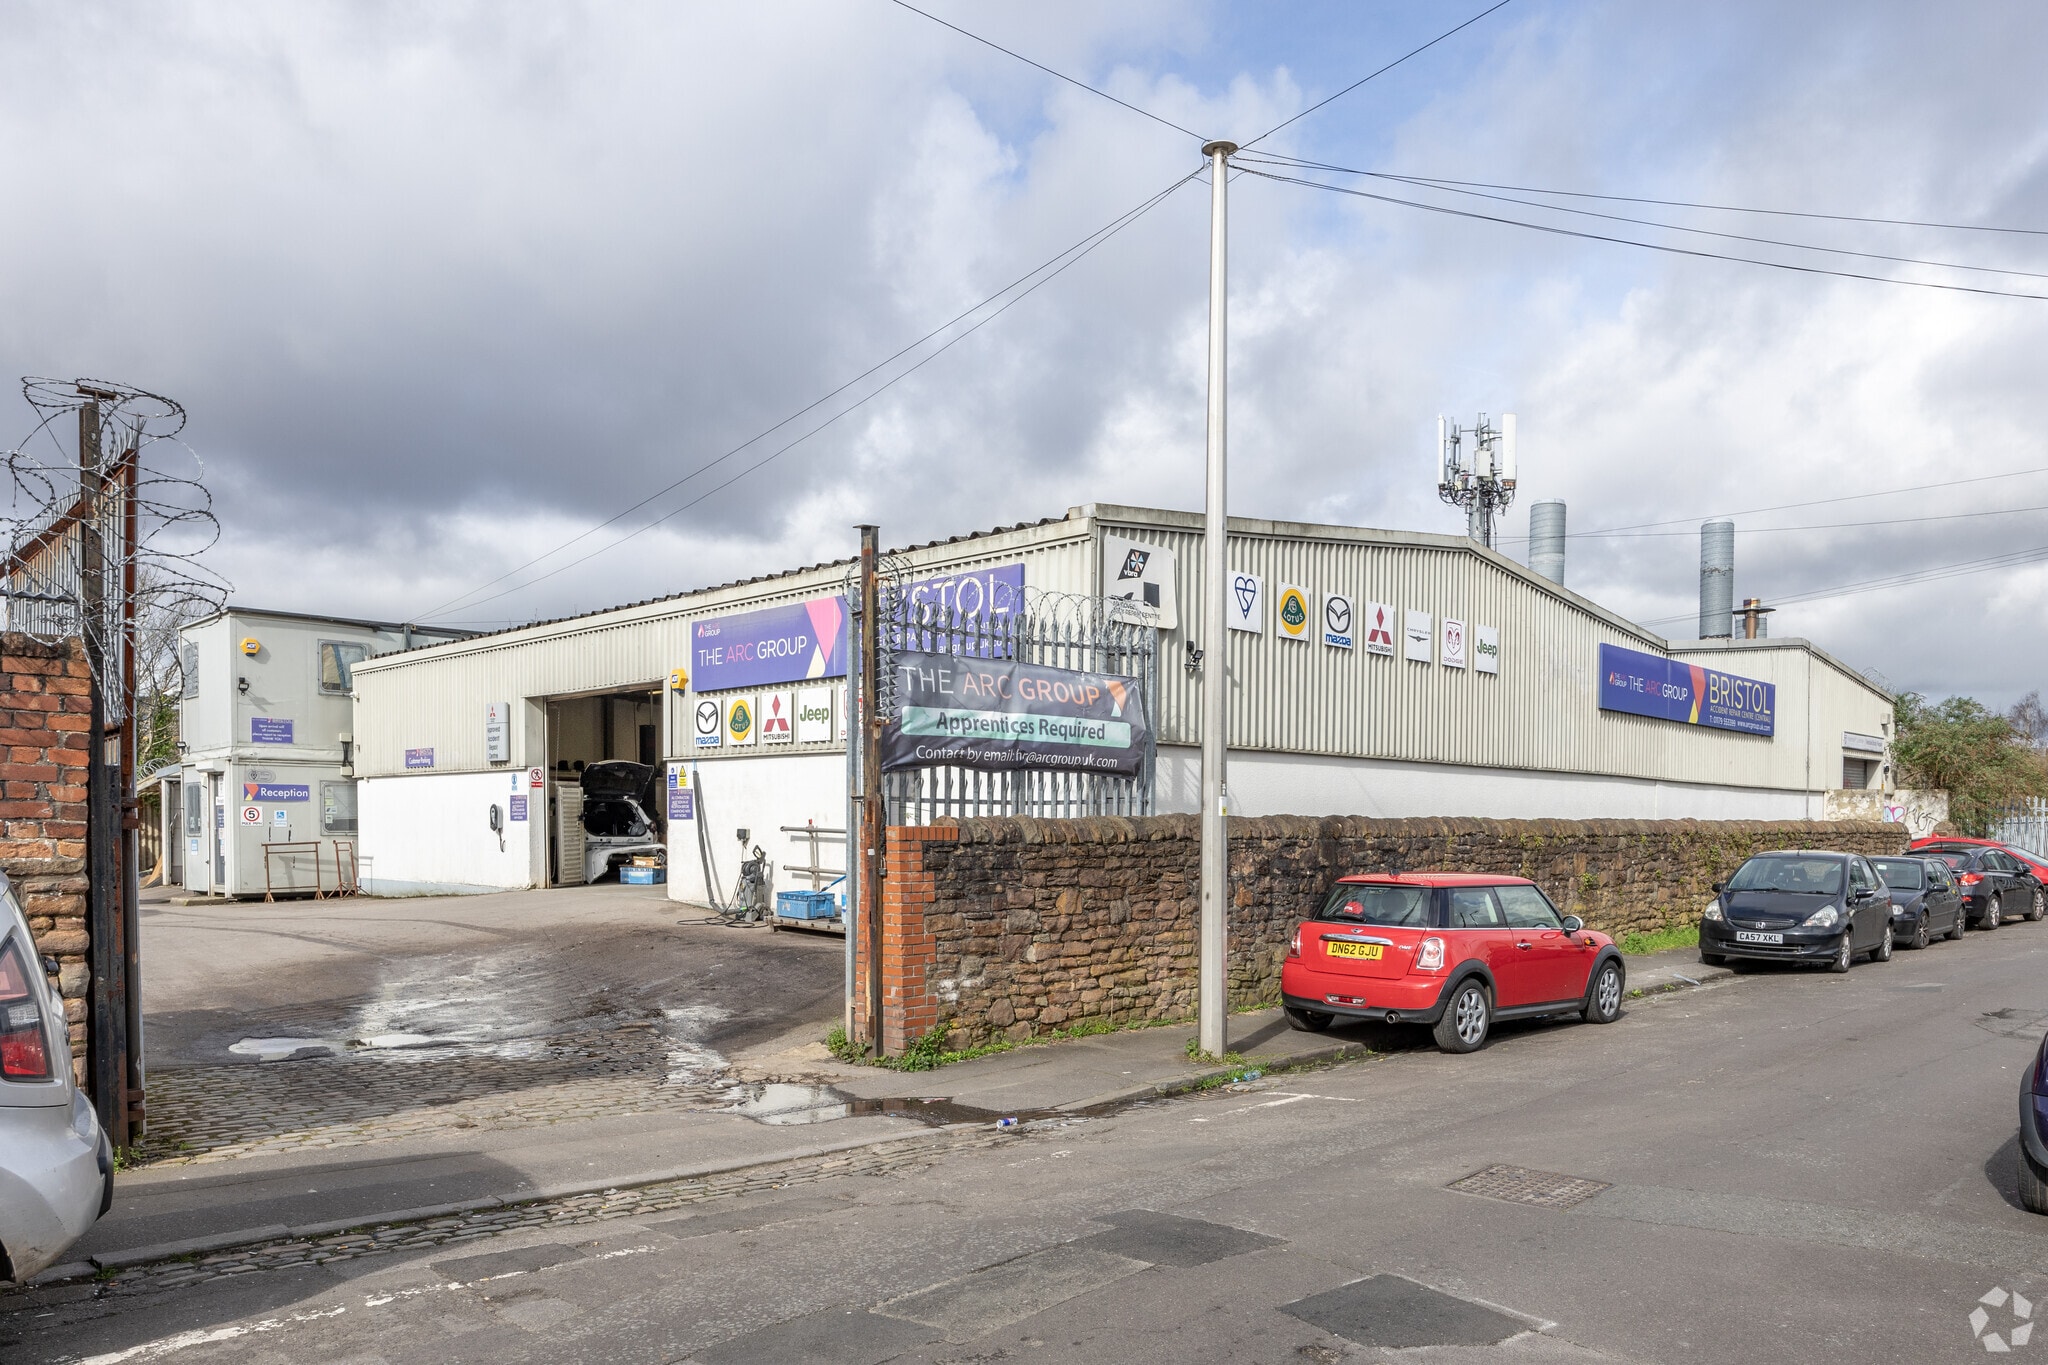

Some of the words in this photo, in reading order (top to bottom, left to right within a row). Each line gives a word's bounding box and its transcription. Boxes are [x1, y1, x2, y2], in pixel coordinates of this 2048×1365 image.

[1283, 611, 1304, 623] LOTUS
[704, 628, 721, 637] GROUP
[1407, 627, 1431, 635] CHRYSLER
[1325, 633, 1351, 646] mazda
[698, 647, 723, 667] THE
[726, 642, 754, 664] ARC
[757, 635, 808, 660] GROUP
[1367, 643, 1392, 653] MITSUBISHI
[1477, 639, 1497, 659] Jeep
[1443, 656, 1464, 665] DODGE
[898, 666, 954, 694] THE
[963, 672, 1012, 699] ARC
[1018, 677, 1100, 706] GROUP
[1615, 679, 1627, 688] GROUP
[1628, 675, 1644, 693] THE
[1645, 681, 1661, 696] ARC
[1662, 684, 1688, 701] GROUP
[1709, 673, 1771, 715] BRISTOL
[799, 704, 830, 724] Jeep
[1710, 705, 1728, 715] ACCIDENT
[1729, 708, 1741, 717] REPAIR
[1741, 710, 1754, 720] CENTRE
[731, 720, 749, 731] LOTUS
[936, 712, 1035, 735] Apprentices
[1039, 719, 1106, 741] Required
[695, 735, 719, 745] mazda
[916, 745, 964, 760] Contact
[967, 747, 982, 763] by
[260, 787, 308, 799] Reception
[248, 810, 256, 819] 5
[1739, 932, 1761, 942] CA57
[1763, 934, 1779, 943] XKL
[1331, 943, 1357, 955] DN62
[1358, 945, 1379, 957] GJU
